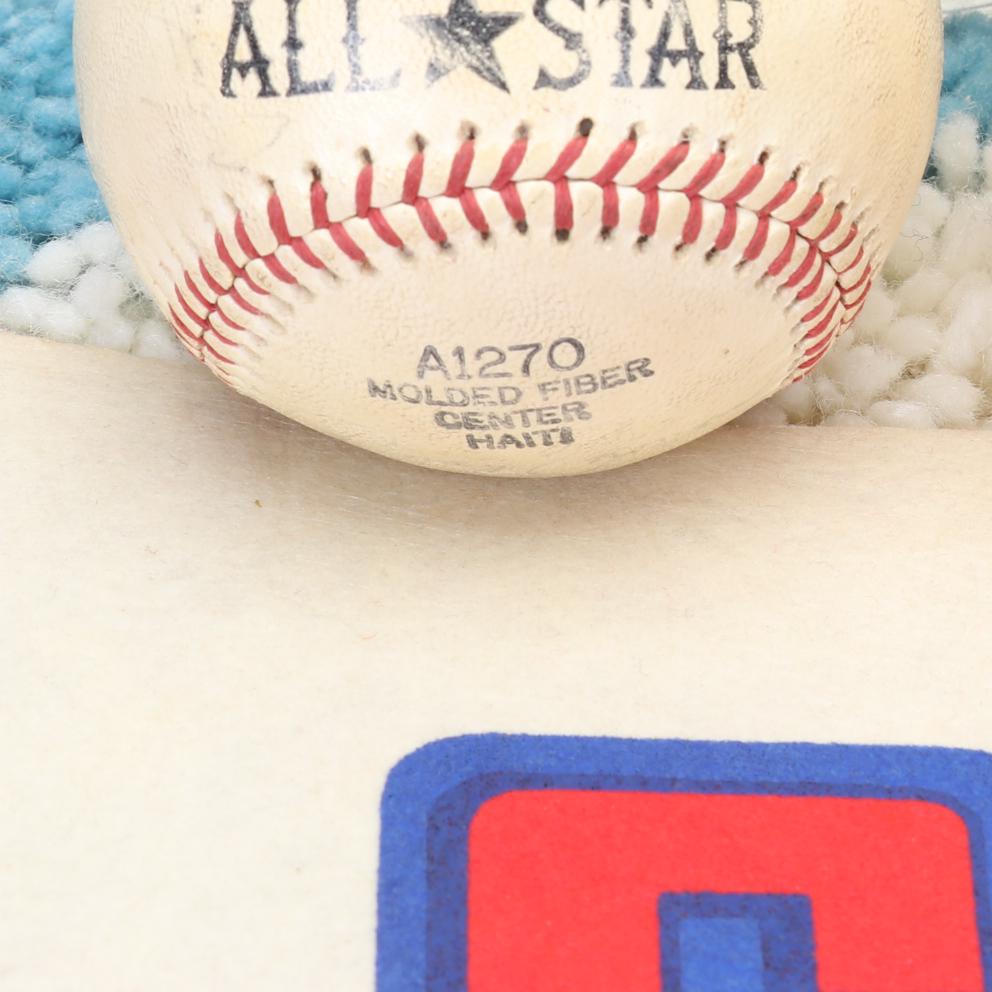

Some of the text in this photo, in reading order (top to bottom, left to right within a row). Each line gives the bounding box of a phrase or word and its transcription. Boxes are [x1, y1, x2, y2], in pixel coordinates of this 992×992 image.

[416, 336, 586, 381] A1270
[366, 356, 656, 408] MOLDED FIBER
[433, 401, 593, 431] CENTER
[464, 425, 576, 450] HAITI
